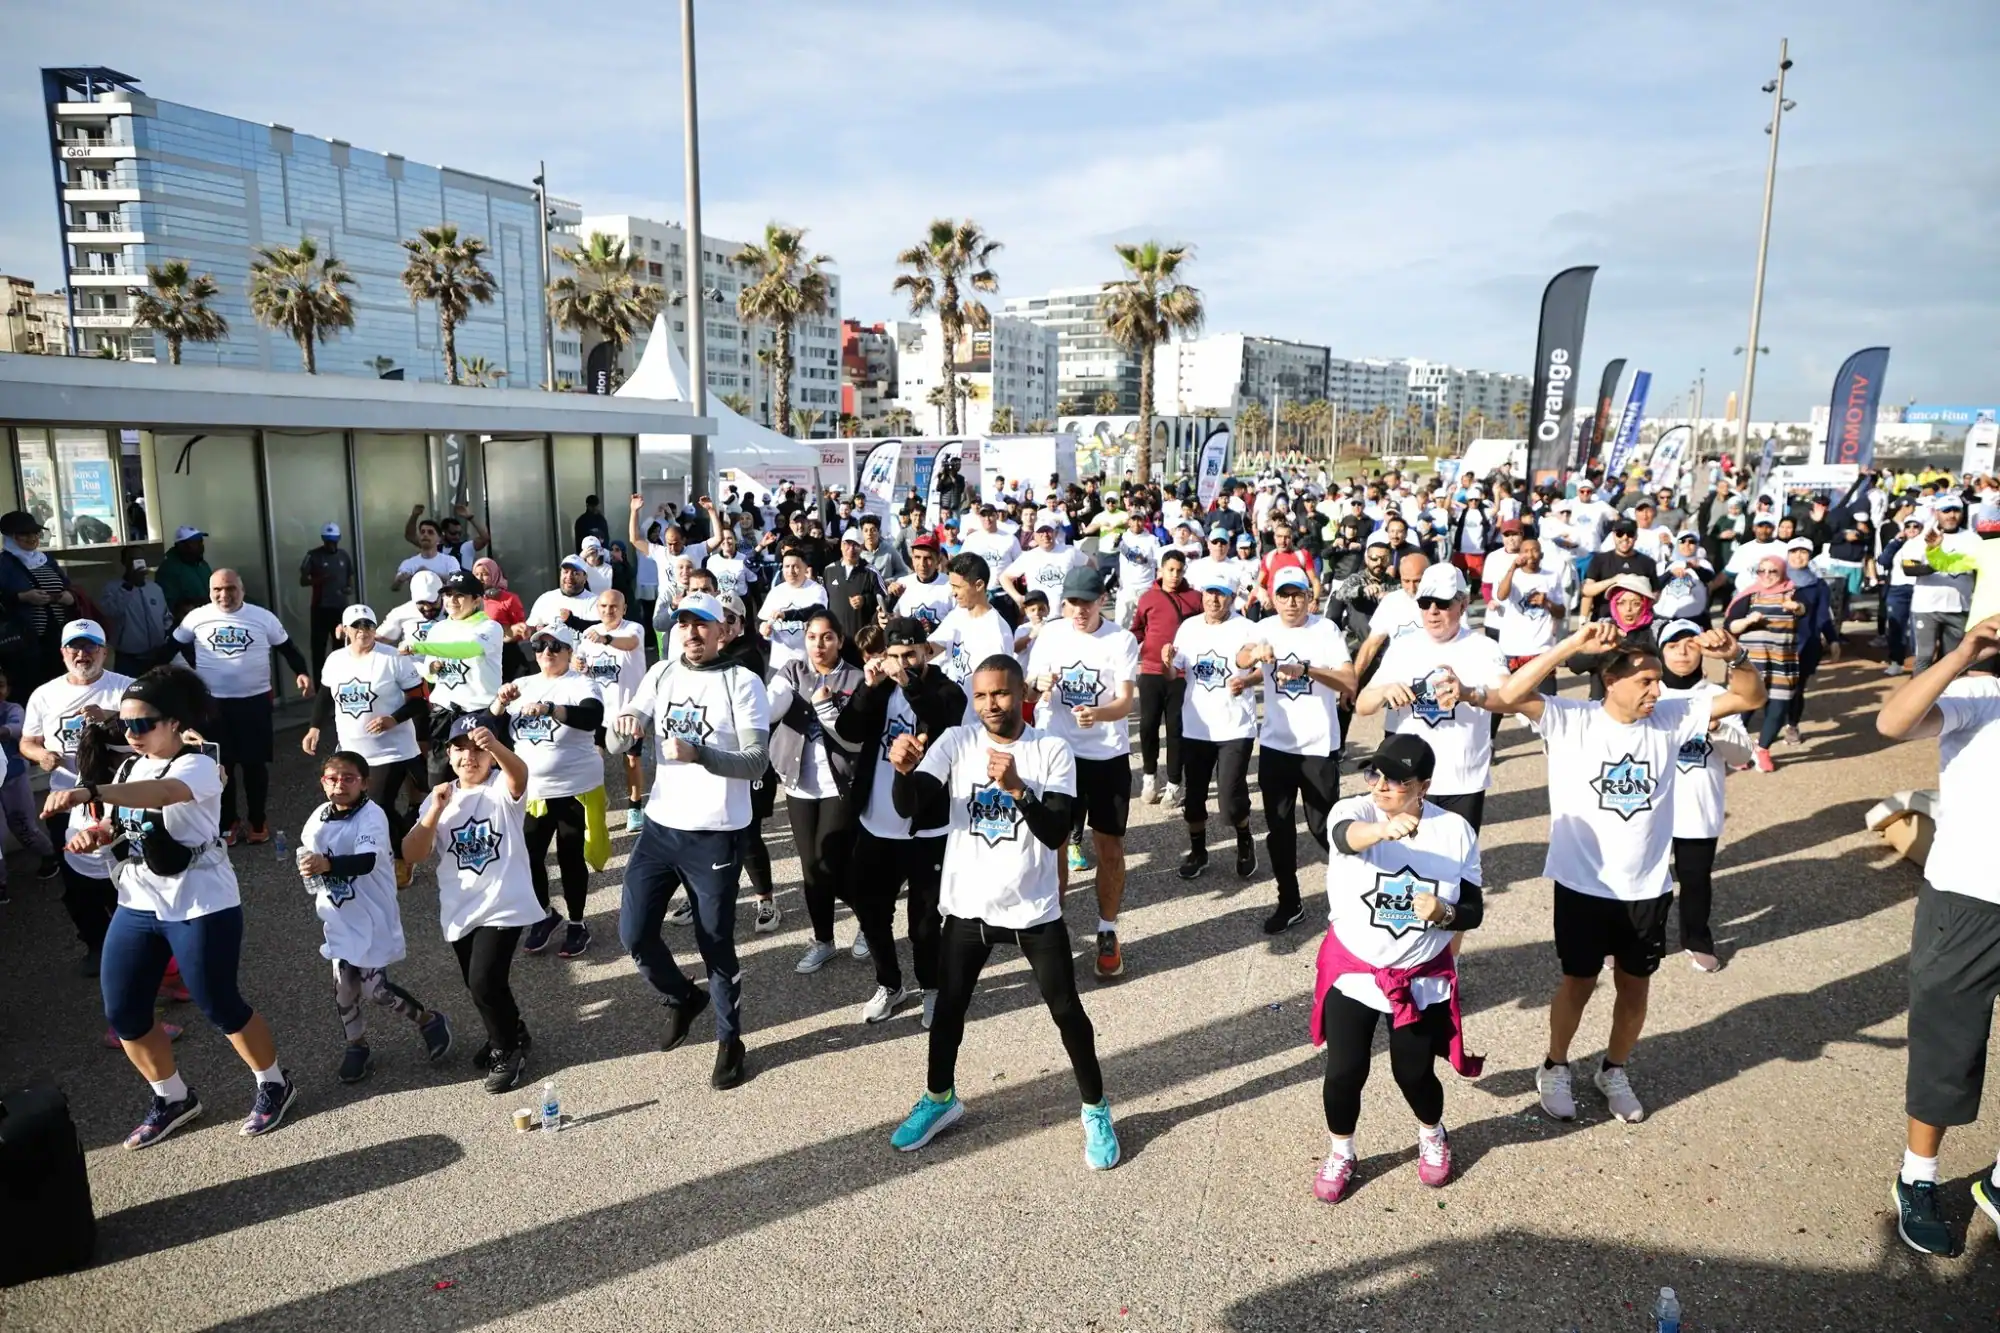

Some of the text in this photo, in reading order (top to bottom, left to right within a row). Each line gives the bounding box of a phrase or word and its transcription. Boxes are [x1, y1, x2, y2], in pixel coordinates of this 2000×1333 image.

[67, 147, 92, 157] Qair
[1538, 348, 1572, 441] Orange
[215, 634, 246, 644] RUN
[593, 666, 617, 675] RUN
[1196, 665, 1226, 677] RUN
[1060, 680, 1097, 693] RUN
[339, 691, 371, 703] RUN
[517, 717, 552, 730] RUN
[666, 717, 703, 736] RUN
[1601, 779, 1651, 795] RUN
[971, 801, 1016, 823] RUN
[455, 834, 494, 856] RUN
[1374, 891, 1414, 911] RU
[1376, 909, 1418, 921] CASABLANC
